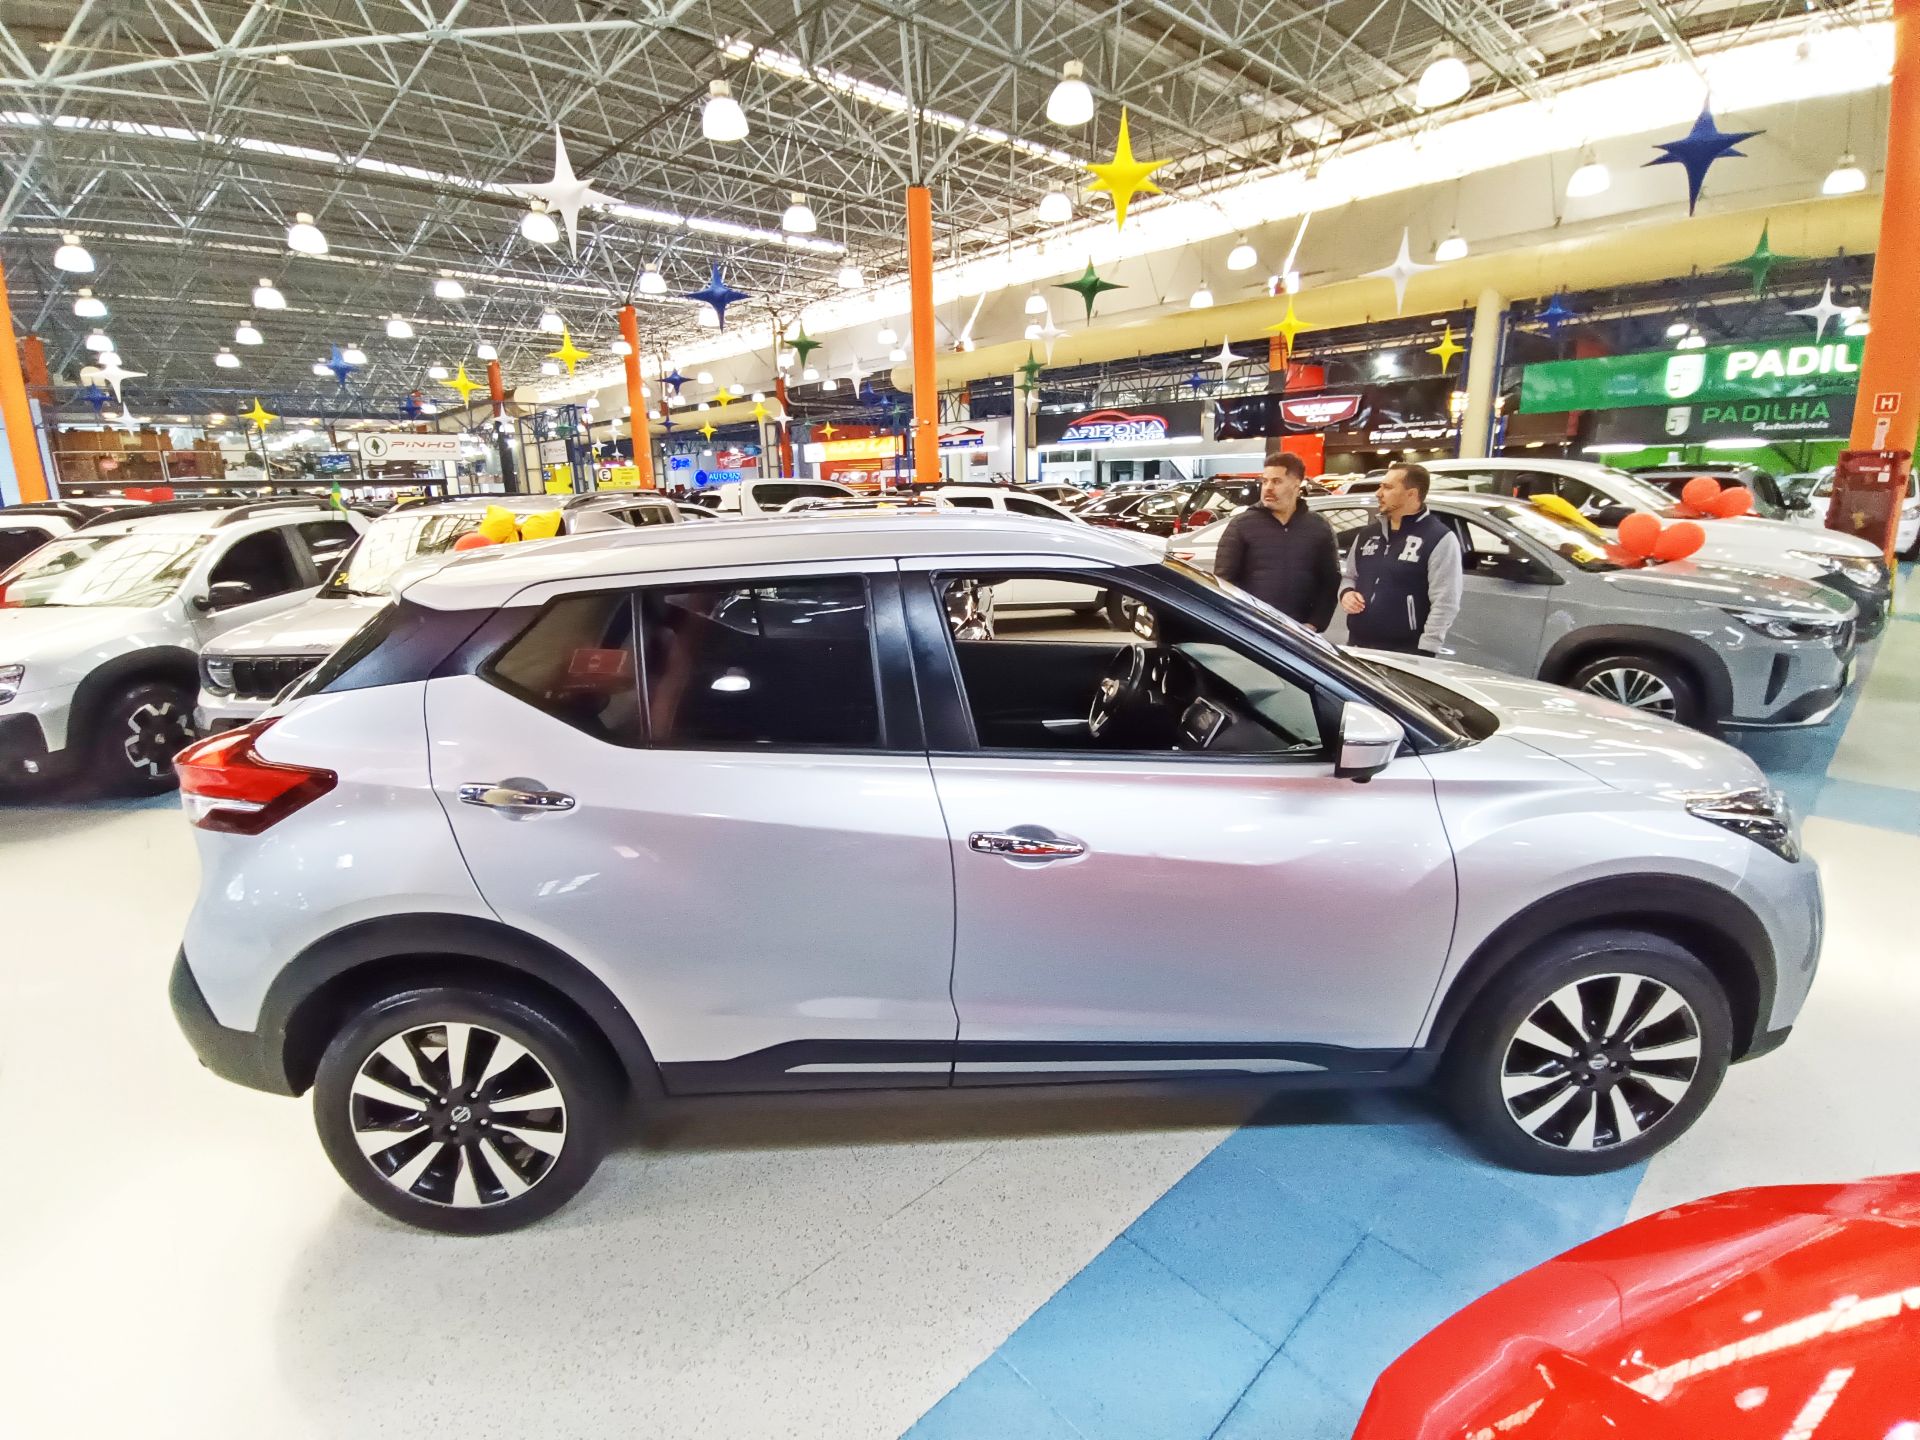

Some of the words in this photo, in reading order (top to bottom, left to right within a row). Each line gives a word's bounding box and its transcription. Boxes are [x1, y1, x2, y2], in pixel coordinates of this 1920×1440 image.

[1880, 397, 1894, 410] H
[1702, 401, 1830, 424] PADILHA
[1061, 420, 1164, 440] ARIZONA
[1752, 421, 1829, 431] Automóveis
[601, 470, 609, 480] E
[1398, 535, 1423, 563] R
